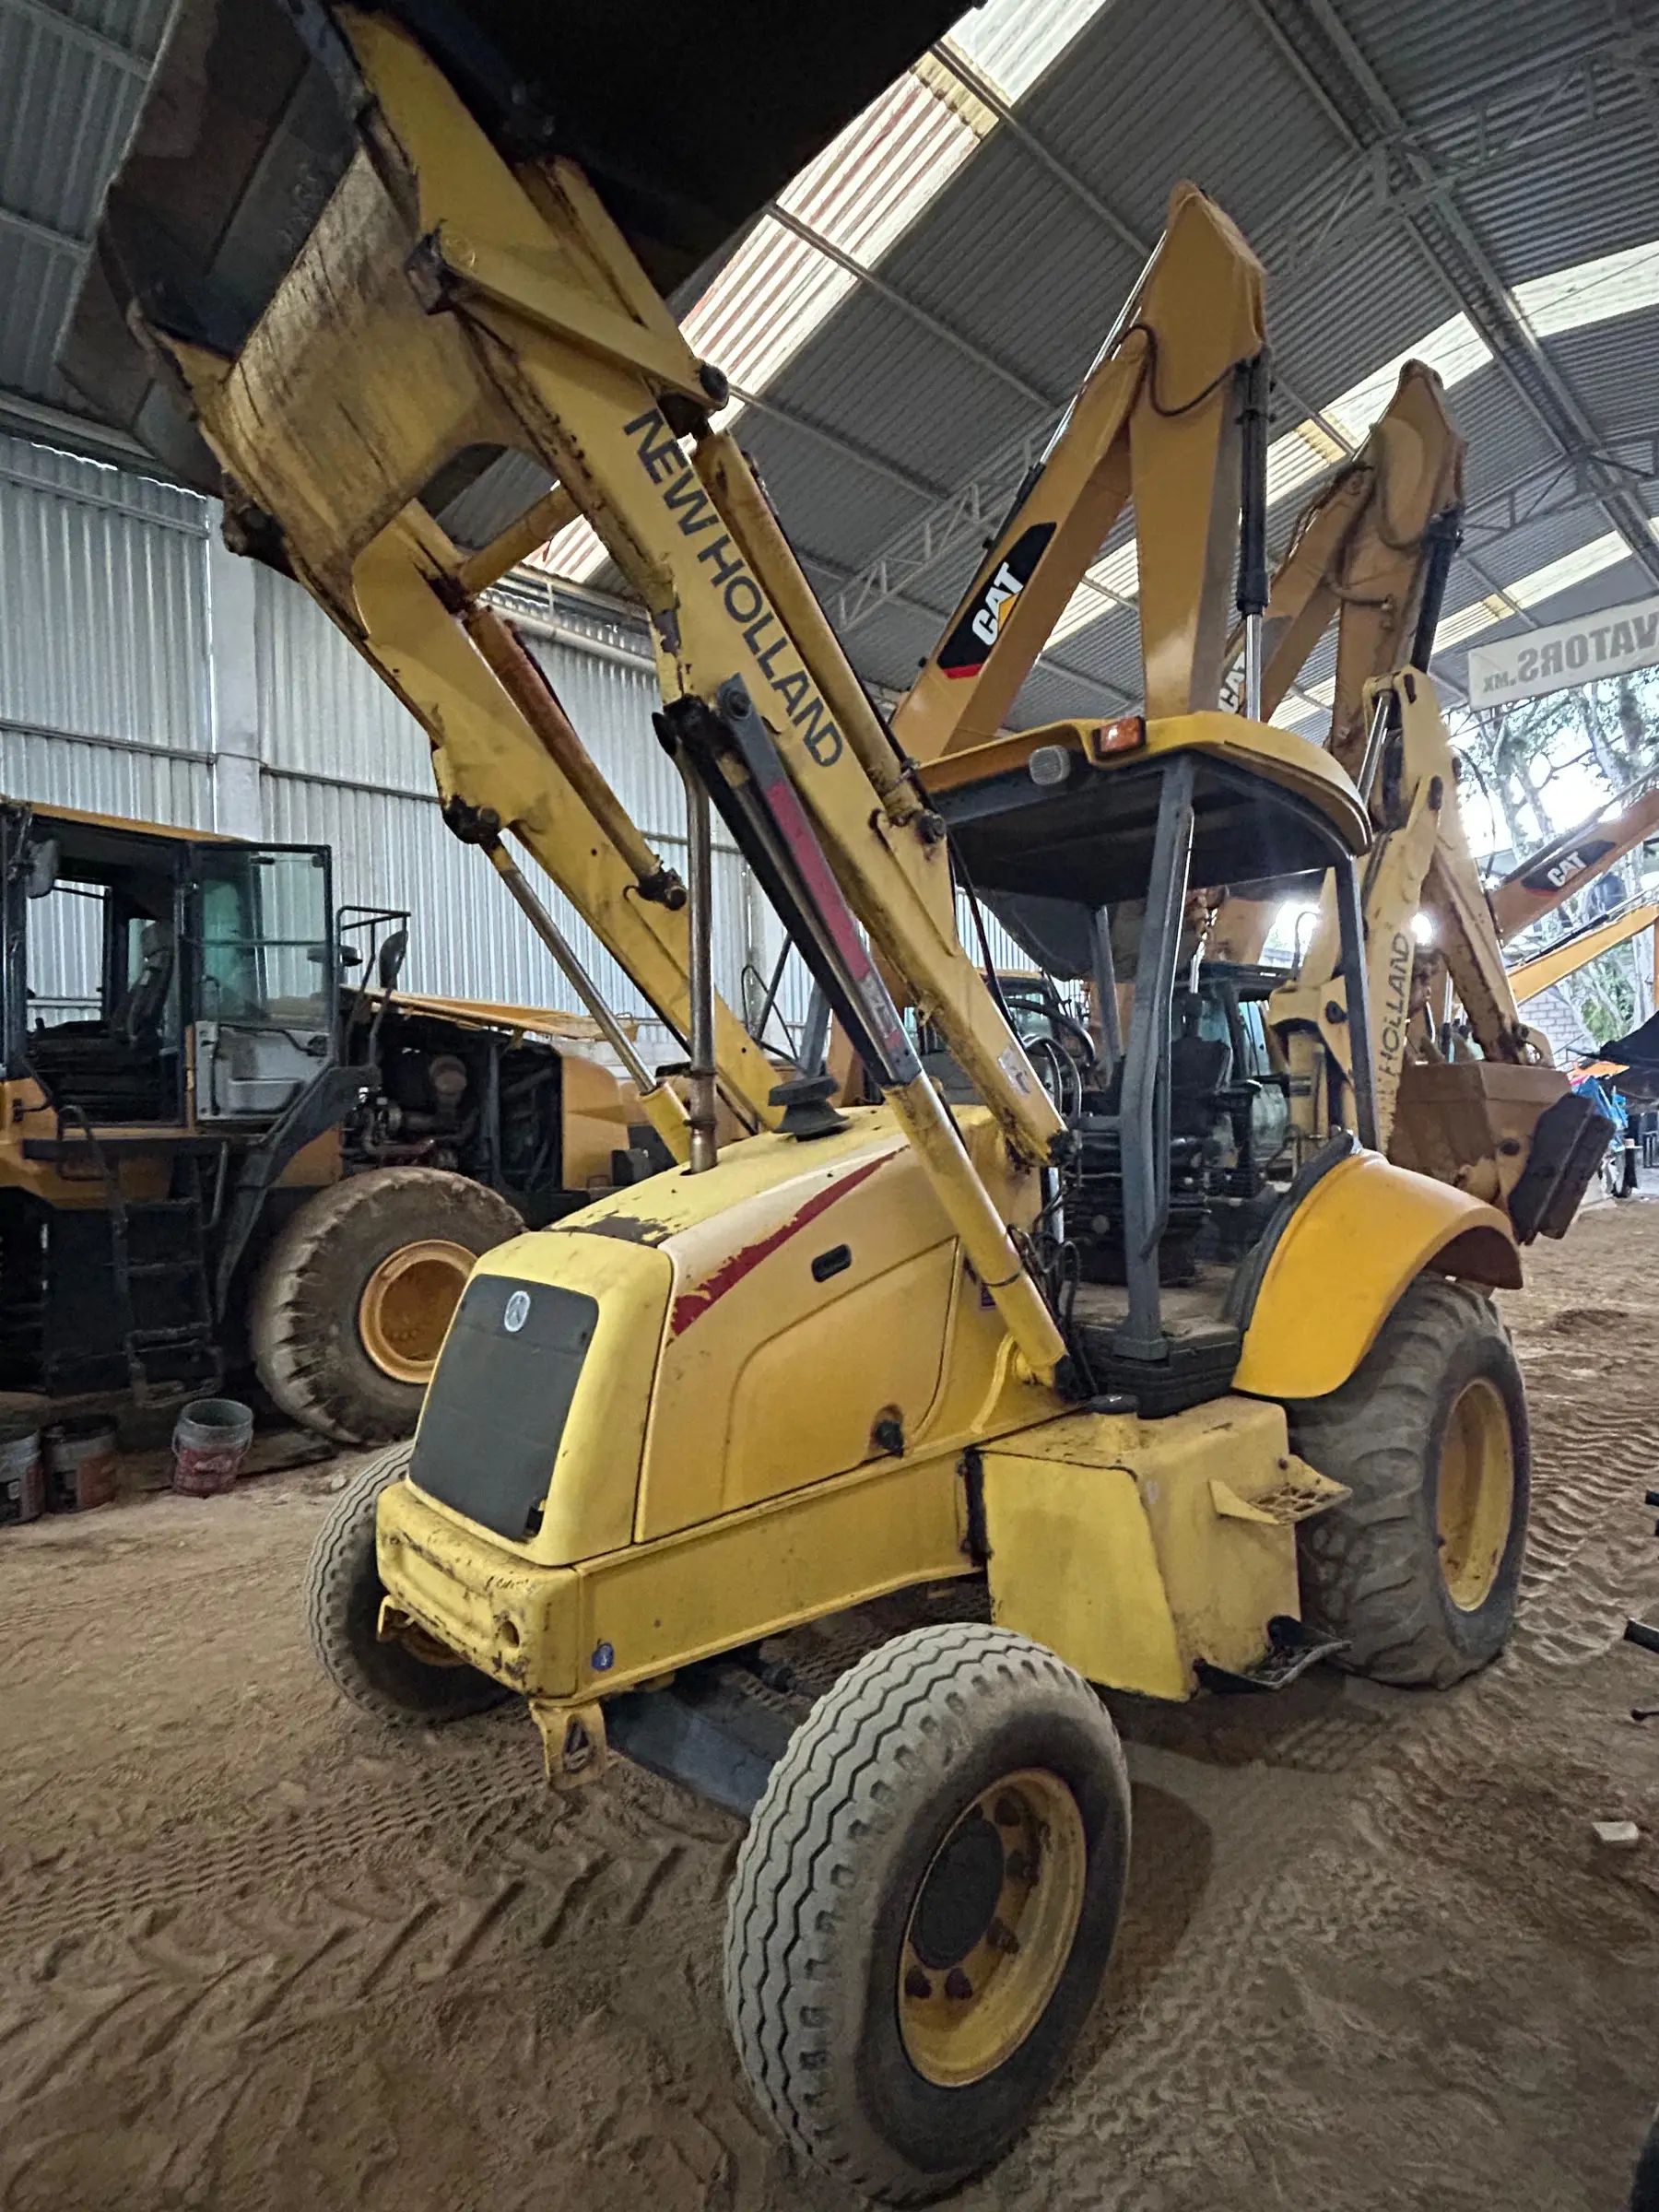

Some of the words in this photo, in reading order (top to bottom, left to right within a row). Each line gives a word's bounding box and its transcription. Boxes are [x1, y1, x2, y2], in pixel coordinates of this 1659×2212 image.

[624, 407, 720, 536] NEW
[698, 534, 844, 768] HOLLAND
[972, 561, 1024, 646] CAT
[1547, 851, 1587, 888] CAT
[1379, 932, 1410, 1077] HOLLAND
